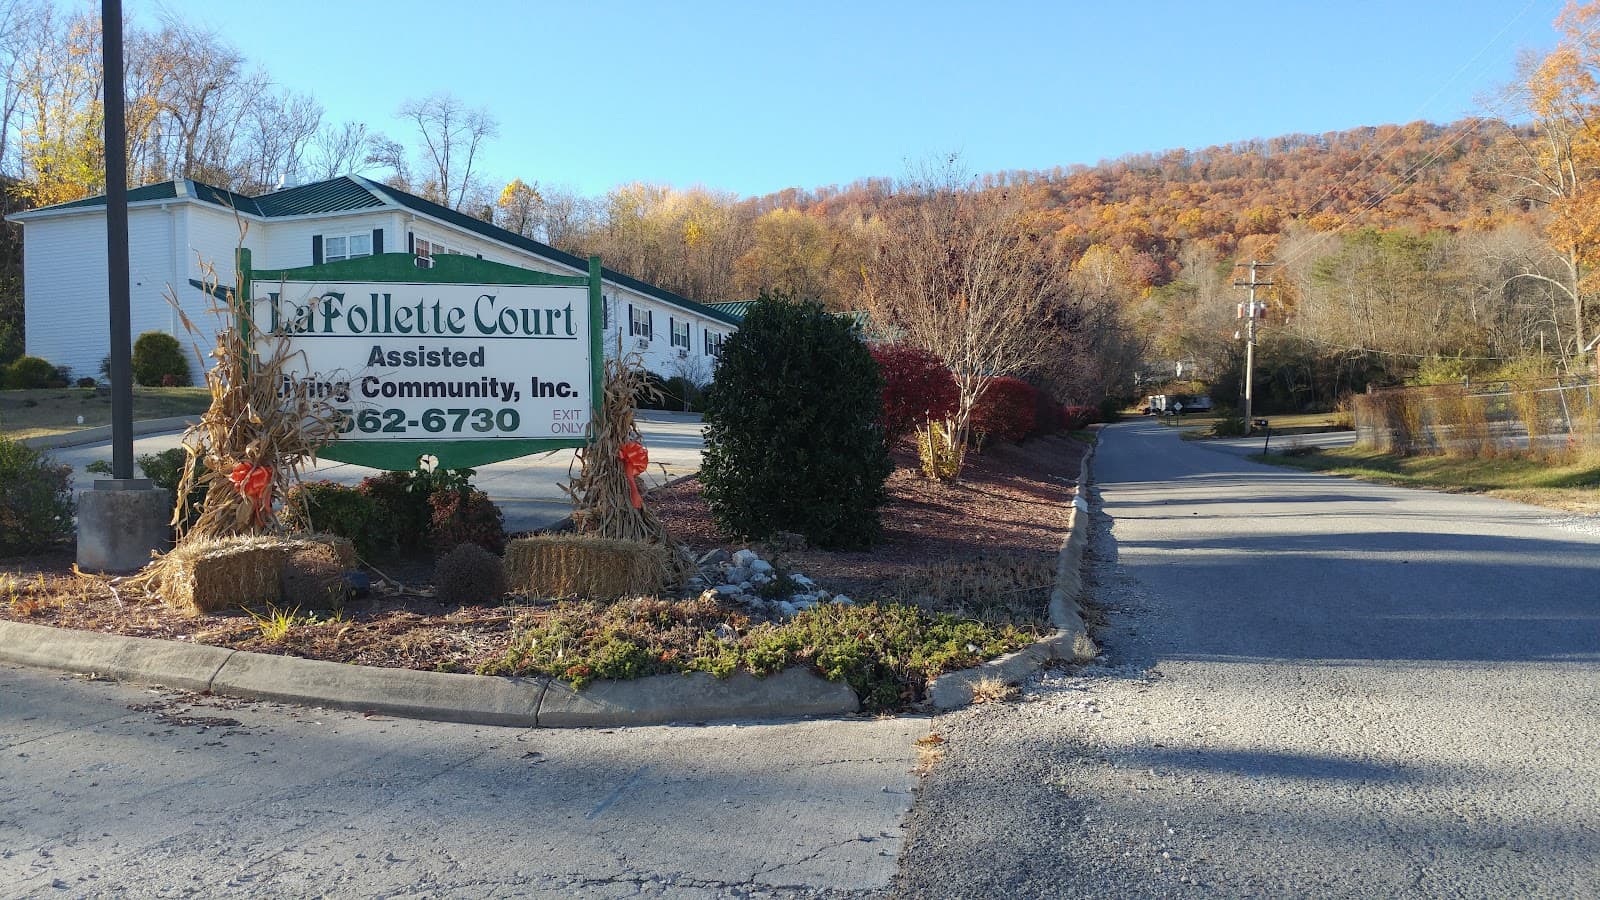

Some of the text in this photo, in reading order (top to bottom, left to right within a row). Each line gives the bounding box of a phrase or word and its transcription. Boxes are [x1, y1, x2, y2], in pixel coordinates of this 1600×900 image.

[267, 292, 578, 336] LaFollette Court
[367, 345, 485, 367] Assisted
[269, 376, 578, 402] iing Community, Inc.
[553, 409, 582, 420] EXIT
[551, 422, 584, 434] ONLY
